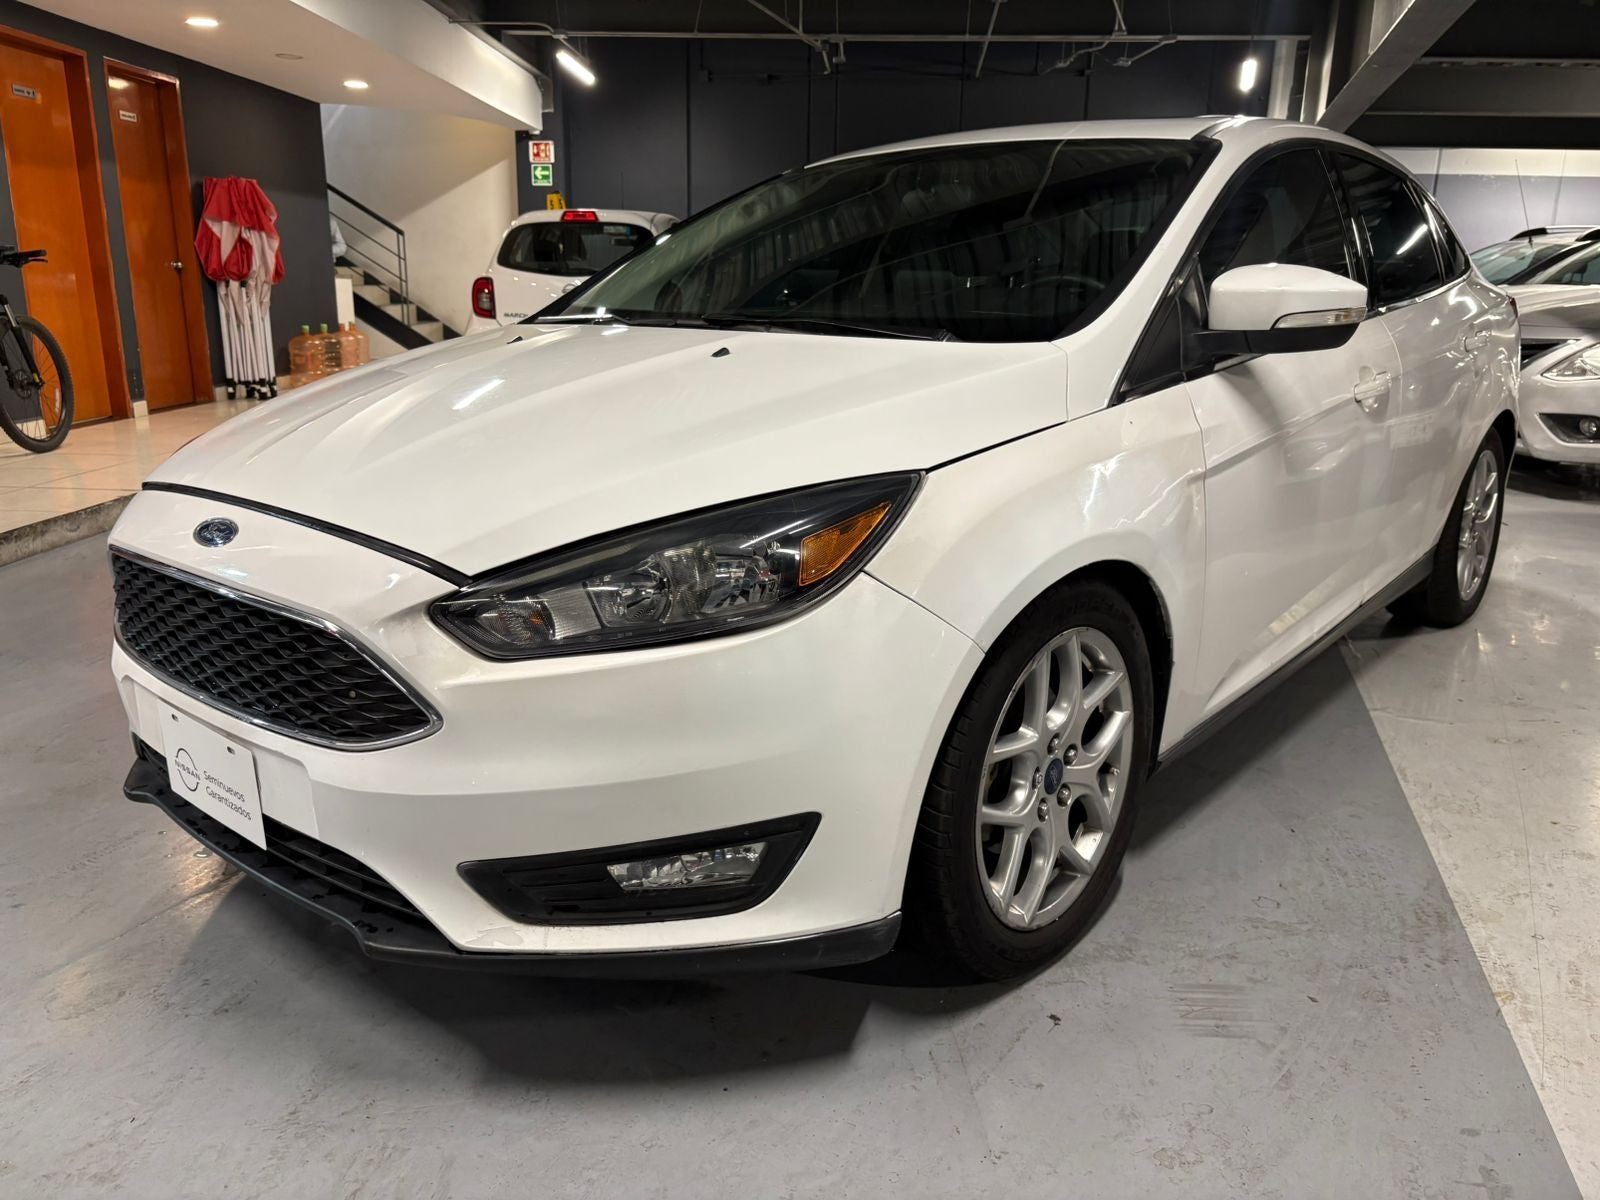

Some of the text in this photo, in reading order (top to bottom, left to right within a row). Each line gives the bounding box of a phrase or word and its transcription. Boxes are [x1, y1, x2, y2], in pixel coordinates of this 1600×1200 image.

[174, 759, 201, 781] NISSAN
[203, 770, 245, 802] Seminuevos
[205, 786, 252, 820] Garantizados
